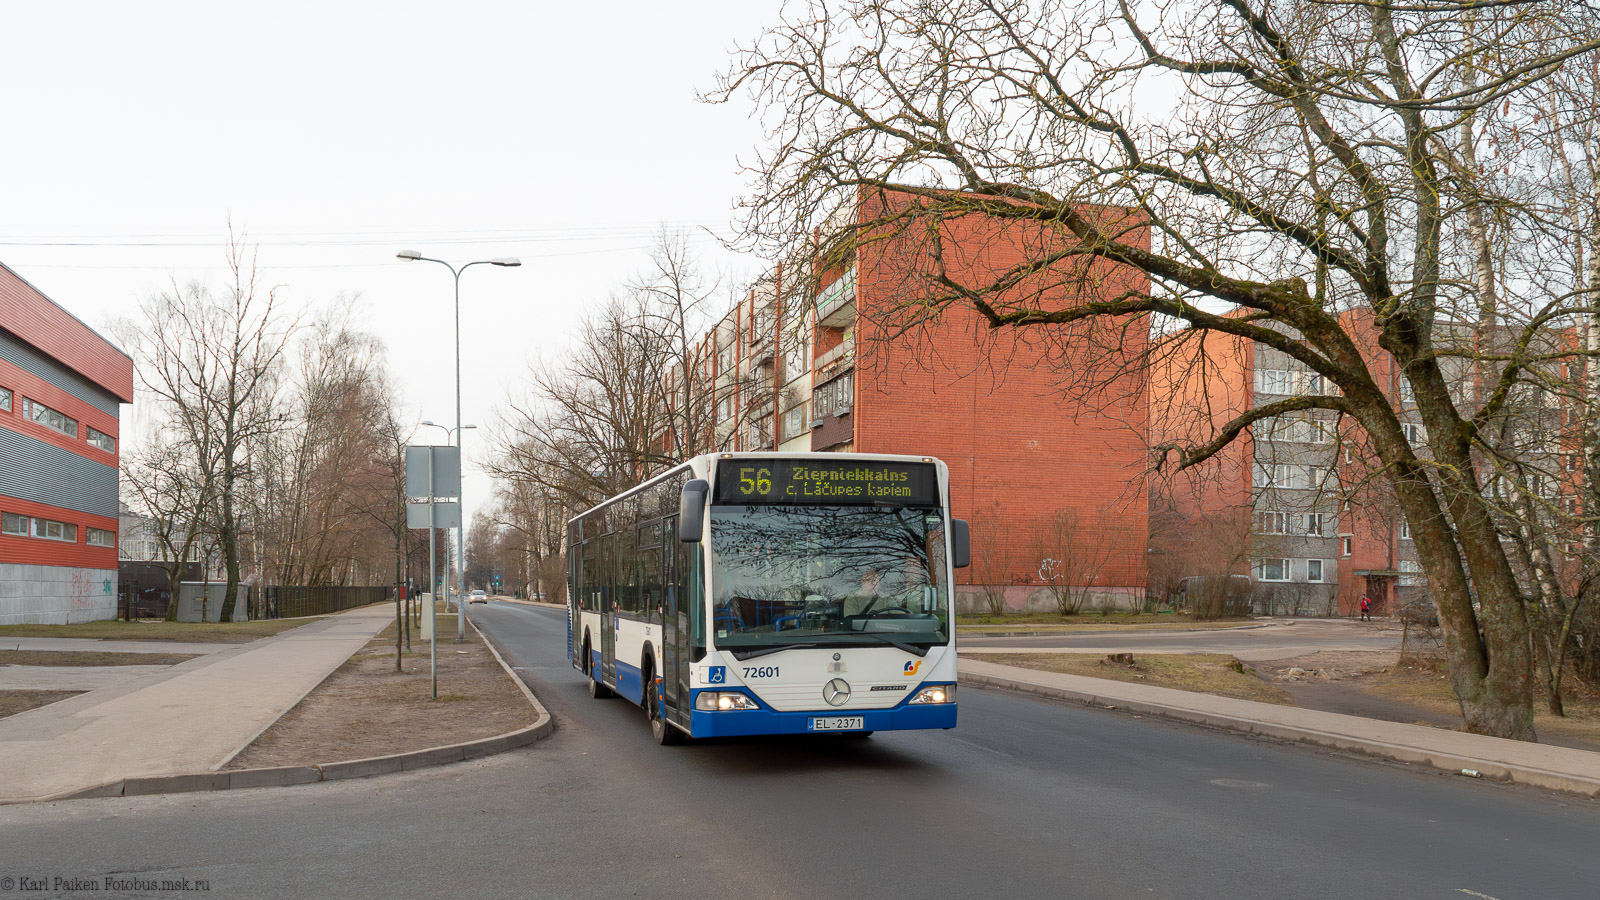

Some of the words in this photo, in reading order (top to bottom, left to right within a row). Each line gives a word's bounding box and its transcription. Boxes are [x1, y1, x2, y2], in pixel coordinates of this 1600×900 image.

[739, 467, 772, 495] 56
[792, 467, 909, 482] Ziepniekkalns
[867, 482, 912, 497] kapiem
[742, 666, 780, 679] 72601
[816, 718, 862, 729] EL-2371
